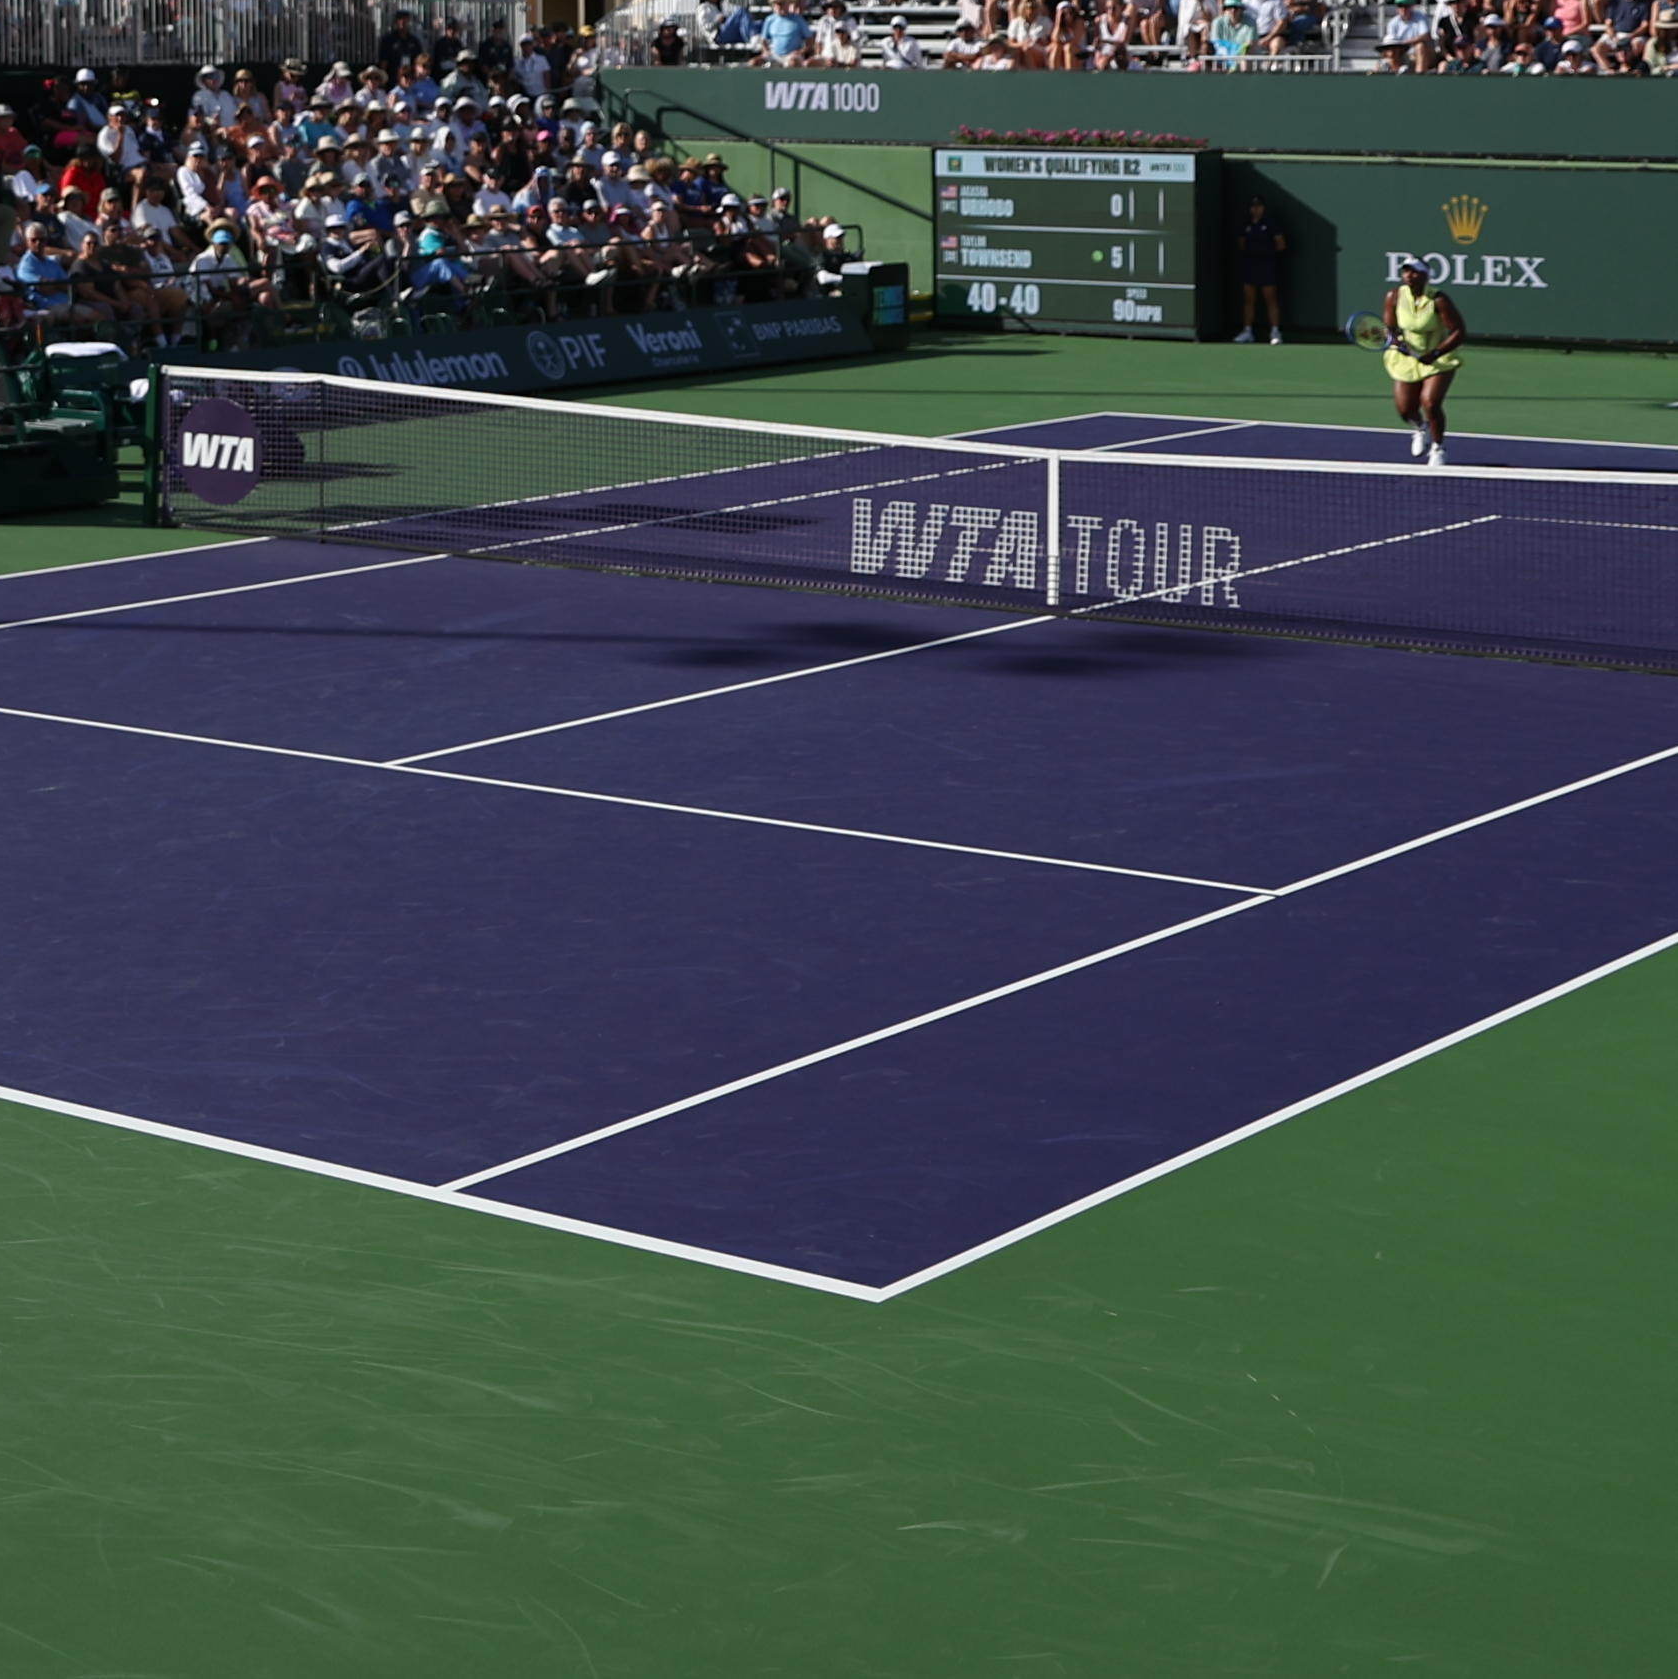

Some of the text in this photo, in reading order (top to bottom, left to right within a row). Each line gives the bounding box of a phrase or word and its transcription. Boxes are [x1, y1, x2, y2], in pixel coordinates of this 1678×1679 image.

[831, 82, 880, 113] 1000
[984, 156, 1141, 178] WOMEN'S QUALIFYING R2
[1110, 193, 1123, 218] 0
[960, 248, 1032, 269] TOWNSEND
[1111, 246, 1123, 269] 5
[625, 319, 703, 354] Veroni
[751, 315, 844, 342] BNP PARIBAS
[558, 332, 608, 371] PIF
[368, 349, 510, 386] lululemon
[183, 431, 255, 473] WTA
[850, 497, 1242, 609] WTA TOUR
